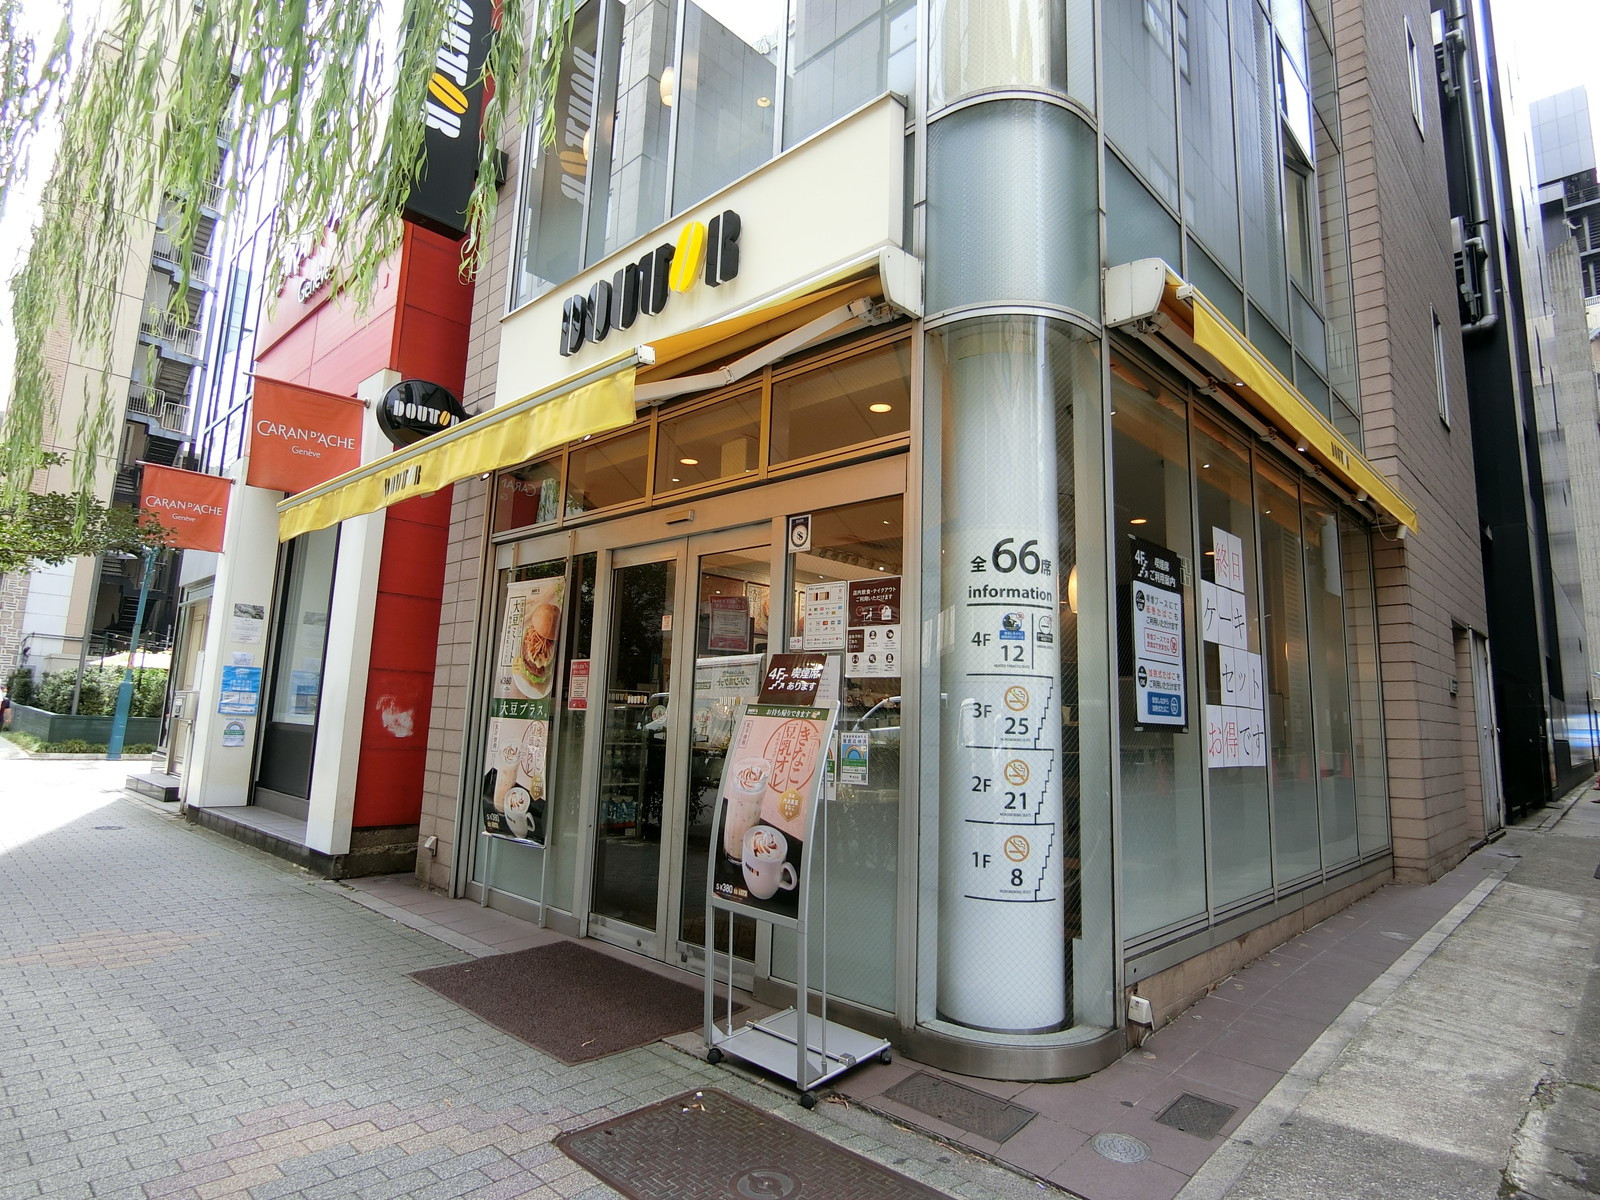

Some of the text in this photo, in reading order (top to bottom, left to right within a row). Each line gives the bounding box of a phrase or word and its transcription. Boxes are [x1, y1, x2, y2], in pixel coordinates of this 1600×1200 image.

[559, 209, 743, 358] DOUTOR
[256, 420, 310, 441] CARAN
[291, 445, 321, 459] Genève
[146, 496, 186, 510] CARAN
[172, 513, 196, 522] Genève
[1214, 541, 1241, 583] 終日
[968, 584, 1053, 602] information
[1203, 597, 1245, 640] ケーキ
[510, 600, 521, 663] 大豆ミート
[970, 632, 991, 647] 4F
[1000, 645, 1025, 662] 12
[768, 668, 786, 680] 4F
[790, 667, 822, 679] 喫煙席
[1222, 663, 1260, 700] セット
[786, 681, 816, 691] あります
[766, 708, 811, 718] お持ち帰りできます
[972, 702, 992, 718] 3F
[1004, 717, 1029, 735] 25
[1208, 721, 1264, 759] お得です
[773, 723, 798, 788] 豆乳オレ
[790, 726, 811, 784] きなこ
[971, 776, 992, 792] 2F
[1004, 792, 1027, 810] 21
[972, 852, 992, 868] 1F
[1010, 868, 1024, 886] 8
